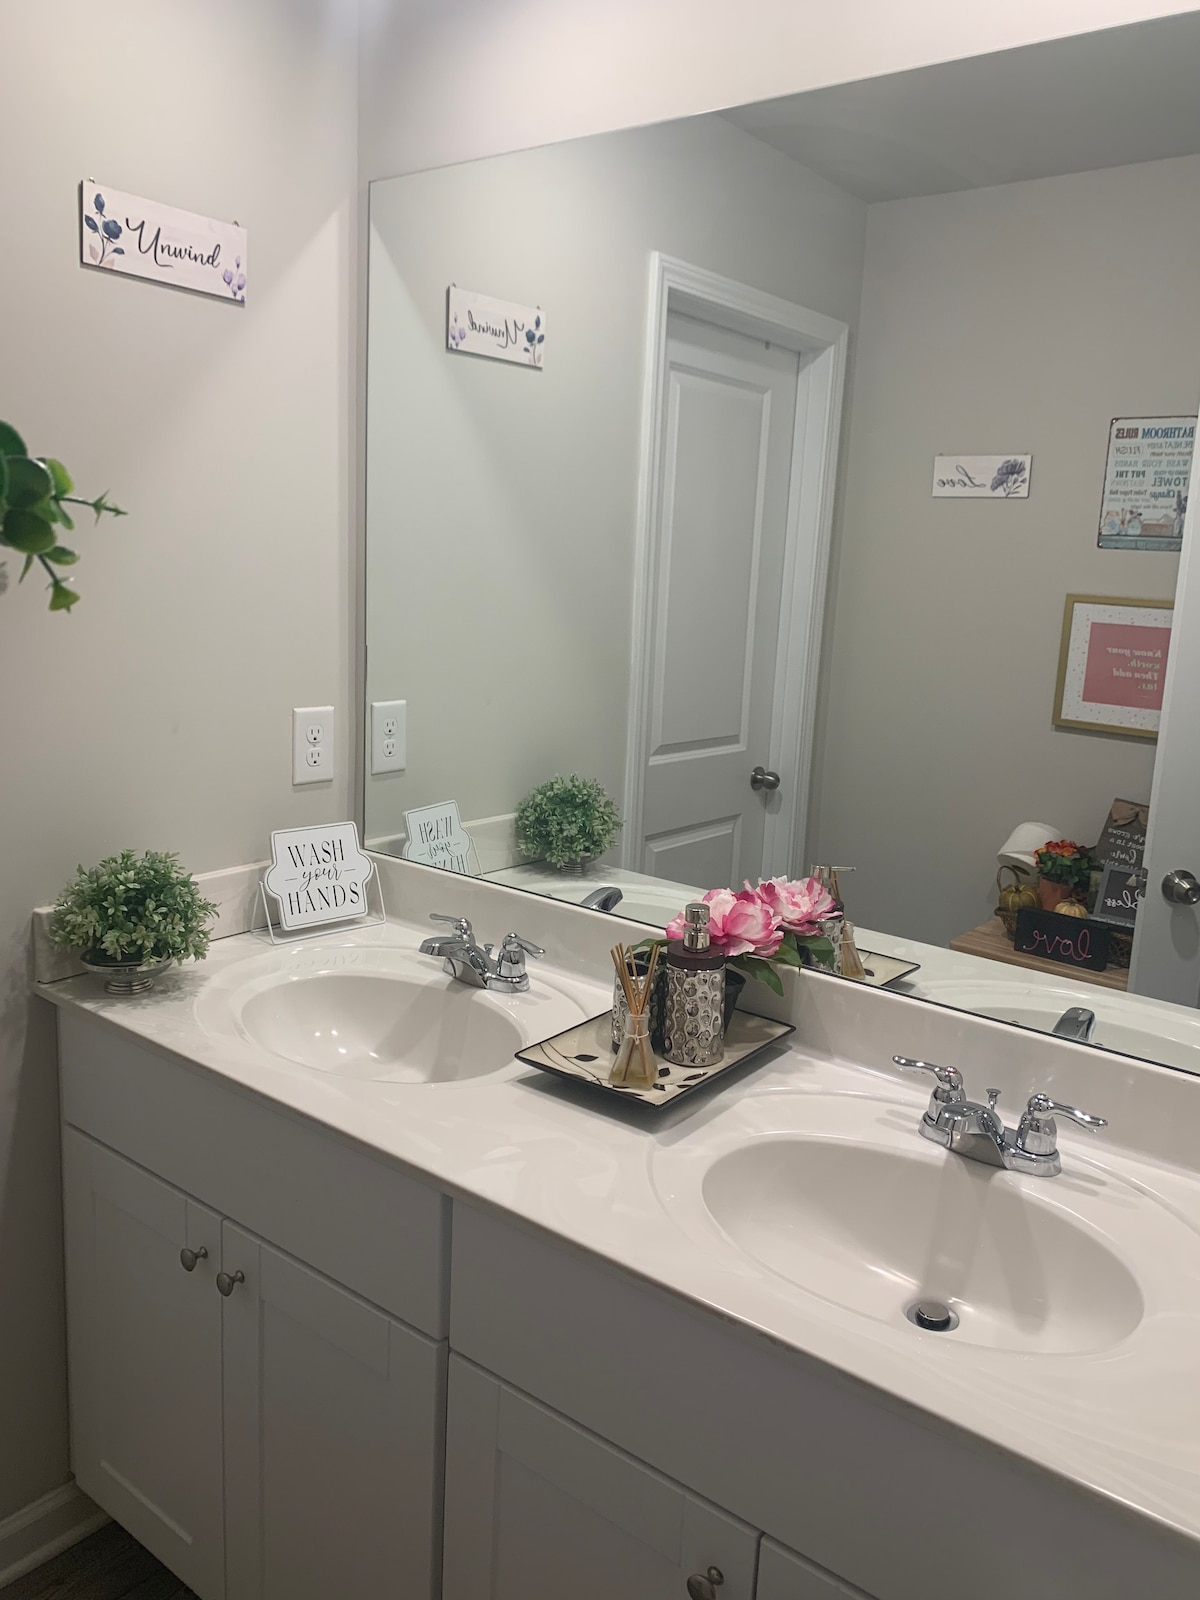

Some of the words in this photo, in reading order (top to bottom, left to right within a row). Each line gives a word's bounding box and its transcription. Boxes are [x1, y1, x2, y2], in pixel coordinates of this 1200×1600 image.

[125, 217, 221, 269] Unwind
[288, 839, 344, 868] WASH
[300, 863, 343, 892] your
[288, 882, 360, 915] HANDS
